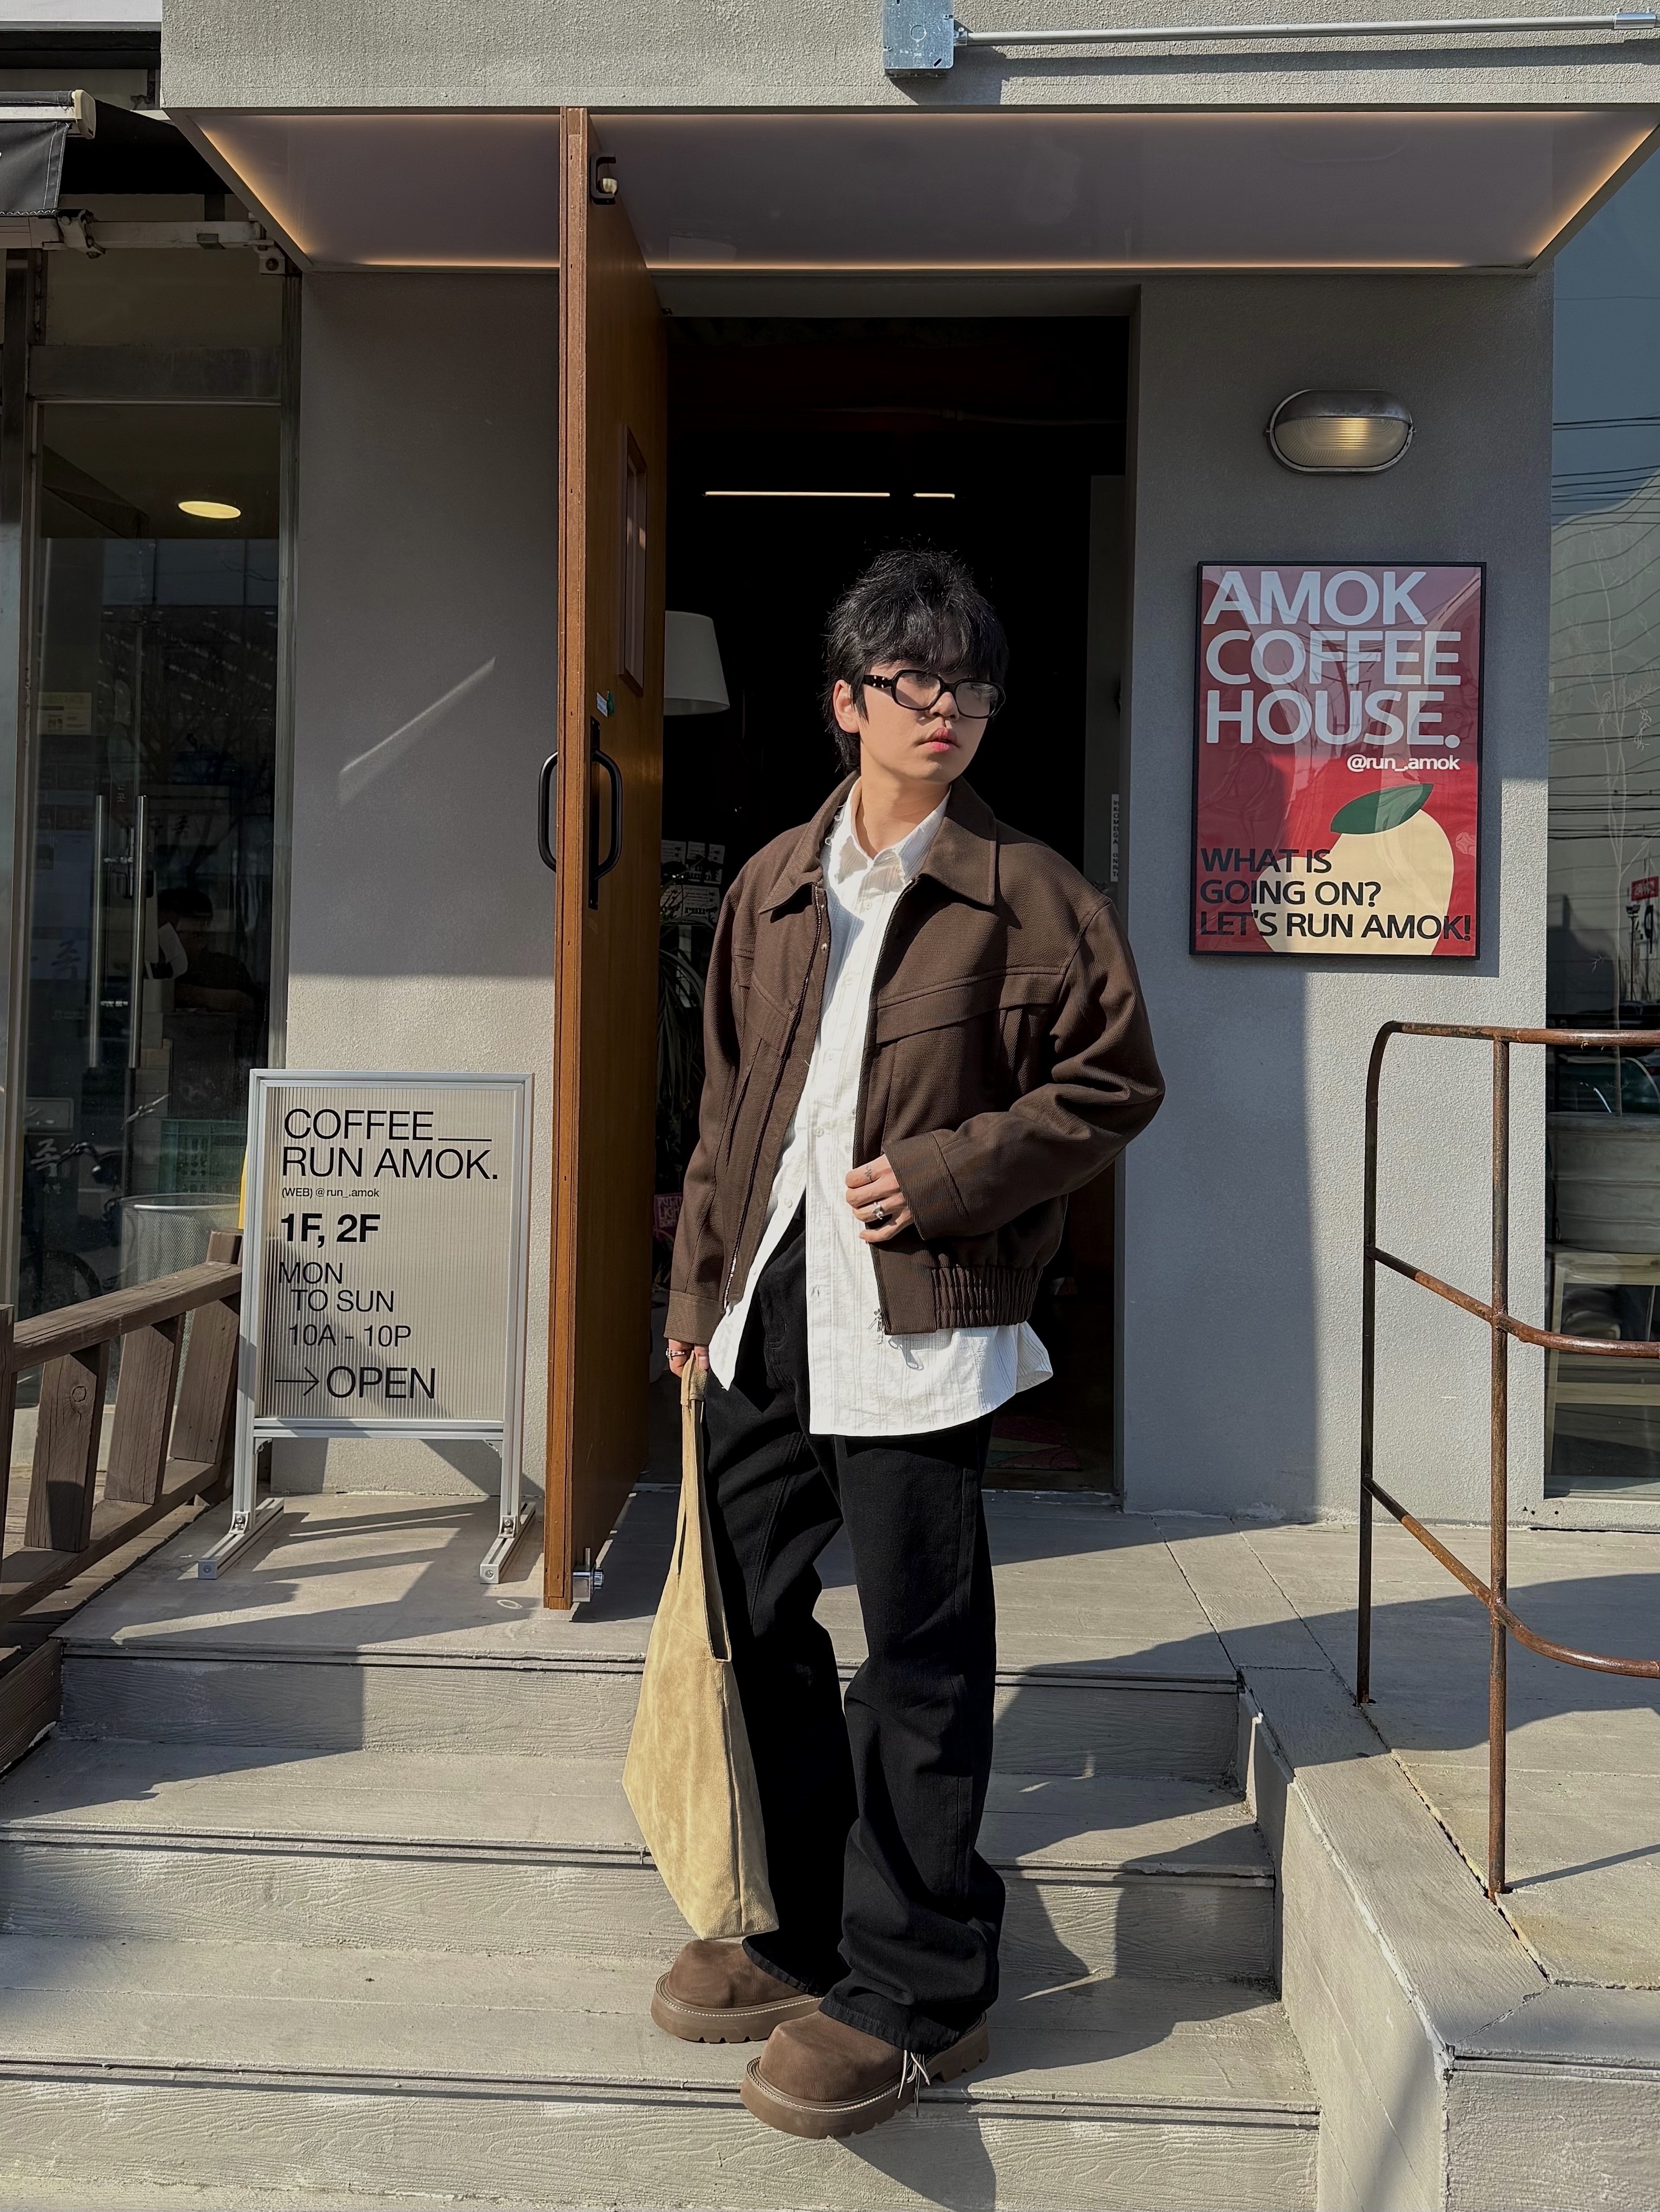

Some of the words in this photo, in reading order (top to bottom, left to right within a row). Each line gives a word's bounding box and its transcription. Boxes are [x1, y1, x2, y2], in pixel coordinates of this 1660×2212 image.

[1203, 571, 1427, 625] AMOK
[1206, 630, 1461, 685] COFFEE
[1206, 690, 1460, 748] HOUSE.
[1201, 848, 1297, 873] WHAT
[1306, 849, 1331, 874] IS
[1200, 880, 1304, 905] GOING
[1315, 881, 1382, 908] ON?
[1200, 911, 1277, 937] LET'S
[1286, 913, 1352, 937] RUN
[1362, 915, 1471, 942] AMOK!
[284, 1108, 434, 1141] COFFEE
[282, 1147, 363, 1177] RUN
[374, 1148, 498, 1180] AMOK.
[282, 1187, 313, 1198] (WEB)
[281, 1213, 325, 1248] 1F,
[336, 1214, 381, 1243] 2F
[278, 1262, 343, 1284] MON
[290, 1289, 328, 1311] TO
[336, 1289, 394, 1312] SUN
[289, 1325, 337, 1346] 10A
[363, 1325, 411, 1347] 10P
[326, 1366, 436, 1399] OPEN
